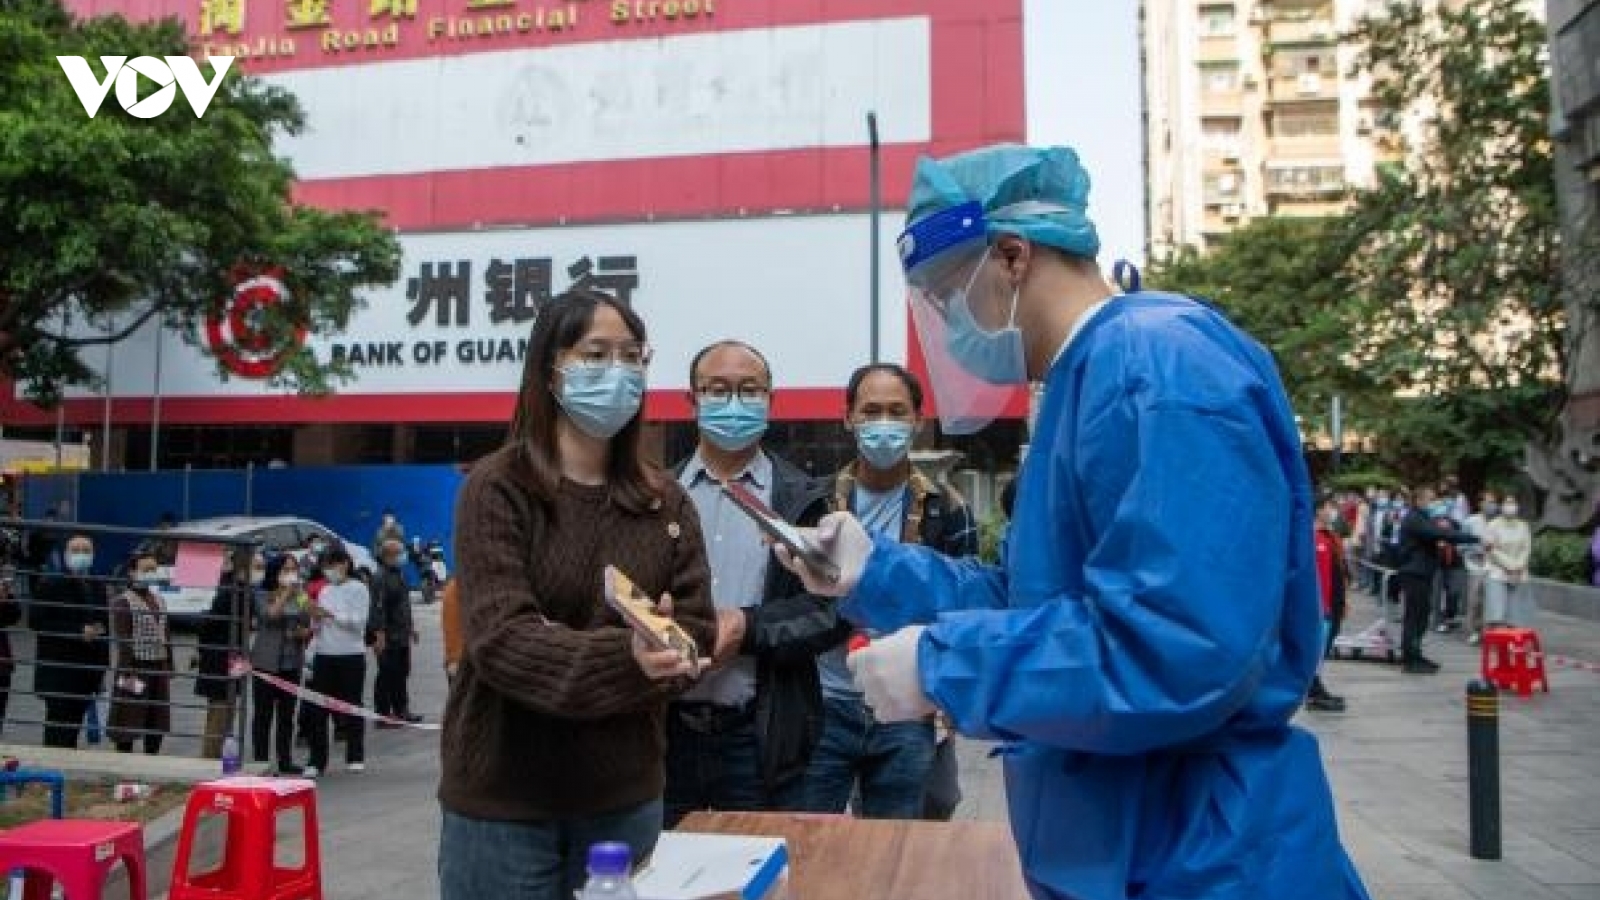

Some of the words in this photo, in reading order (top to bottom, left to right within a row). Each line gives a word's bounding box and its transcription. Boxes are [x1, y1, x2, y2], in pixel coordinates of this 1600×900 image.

[321, 23, 399, 50] Road
[428, 5, 577, 39] Financial
[609, 0, 715, 21] Street
[331, 342, 403, 366] BANK
[413, 340, 447, 363] OF
